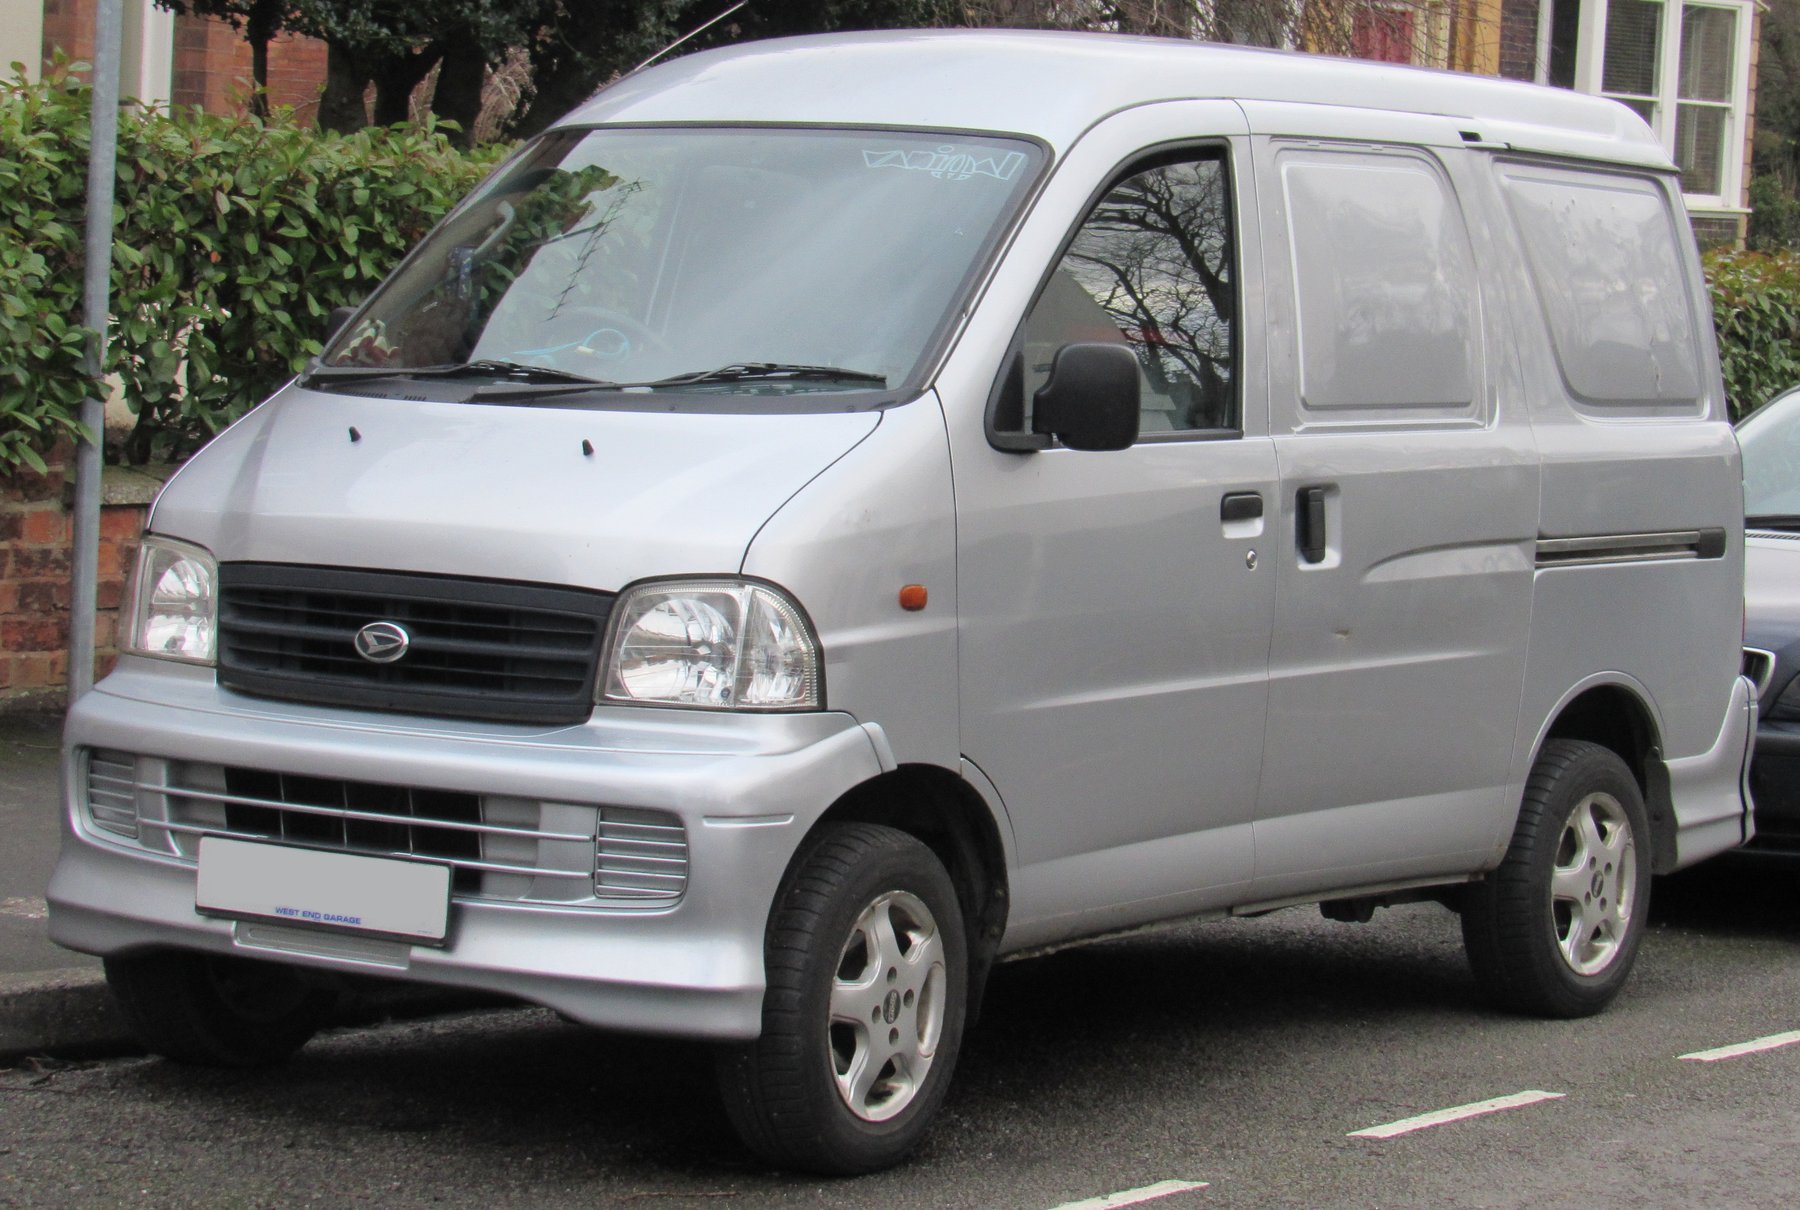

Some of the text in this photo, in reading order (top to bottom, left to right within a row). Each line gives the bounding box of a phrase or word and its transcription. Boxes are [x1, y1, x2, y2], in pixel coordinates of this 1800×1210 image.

[275, 906, 362, 925] WEST END GARAGE
